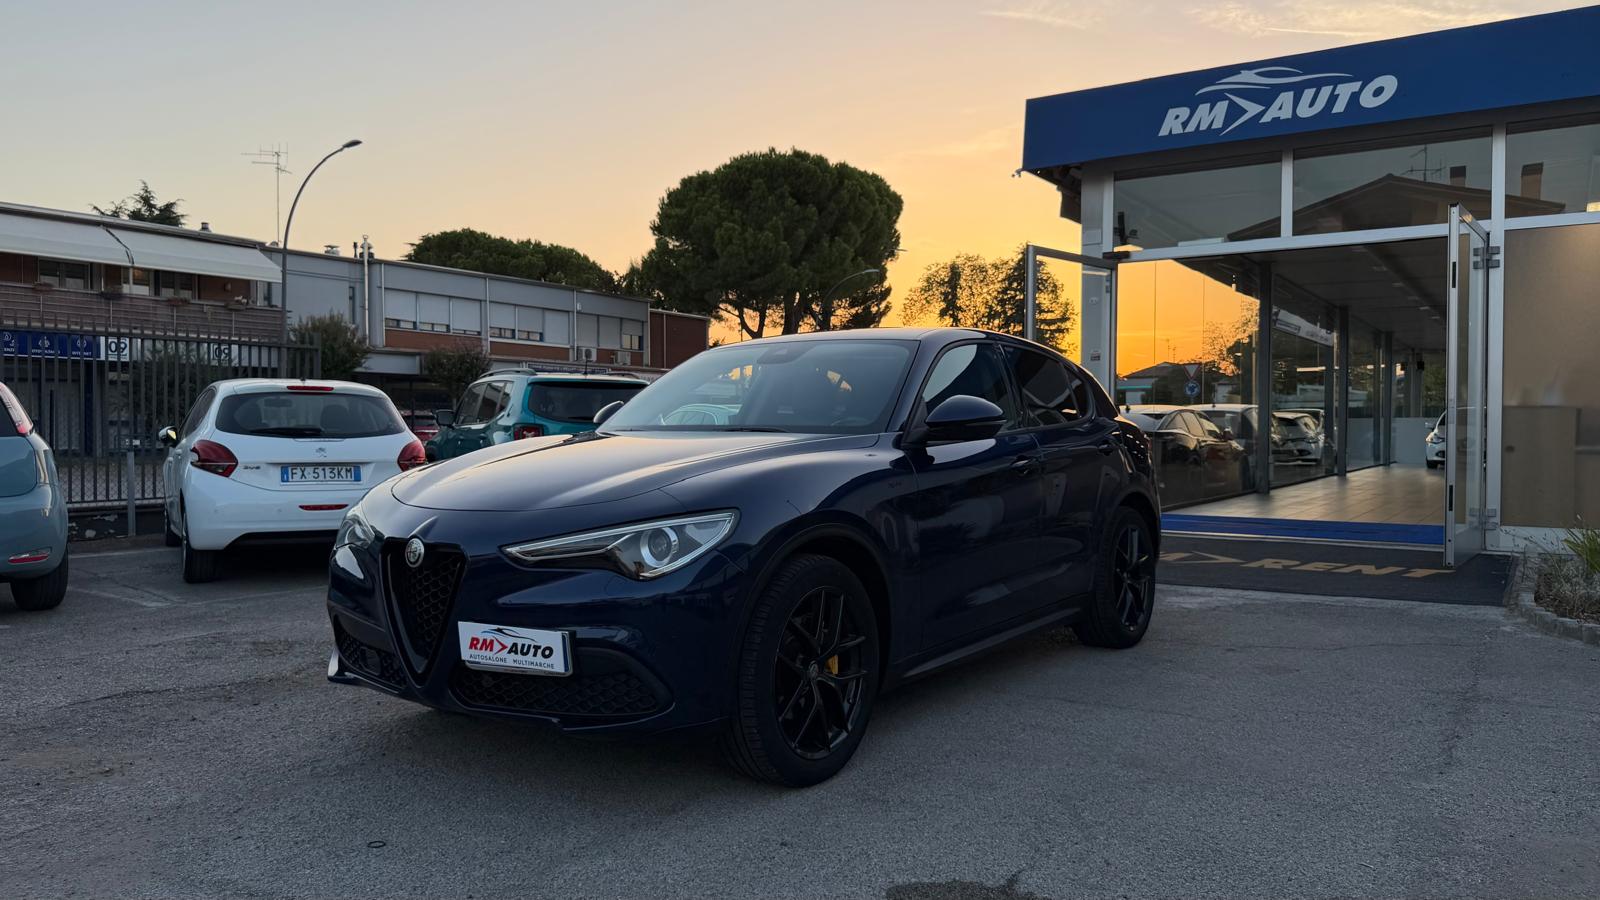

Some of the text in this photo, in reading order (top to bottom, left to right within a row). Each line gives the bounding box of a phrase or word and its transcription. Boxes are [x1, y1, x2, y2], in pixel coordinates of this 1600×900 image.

[1158, 74, 1398, 136] RM AUTO
[290, 467, 353, 479] FX 513KM
[1240, 557, 1457, 578] RENT
[469, 636, 554, 659] RM AUTO
[469, 653, 555, 669] AUTOSALONE MULTIMARCHE
